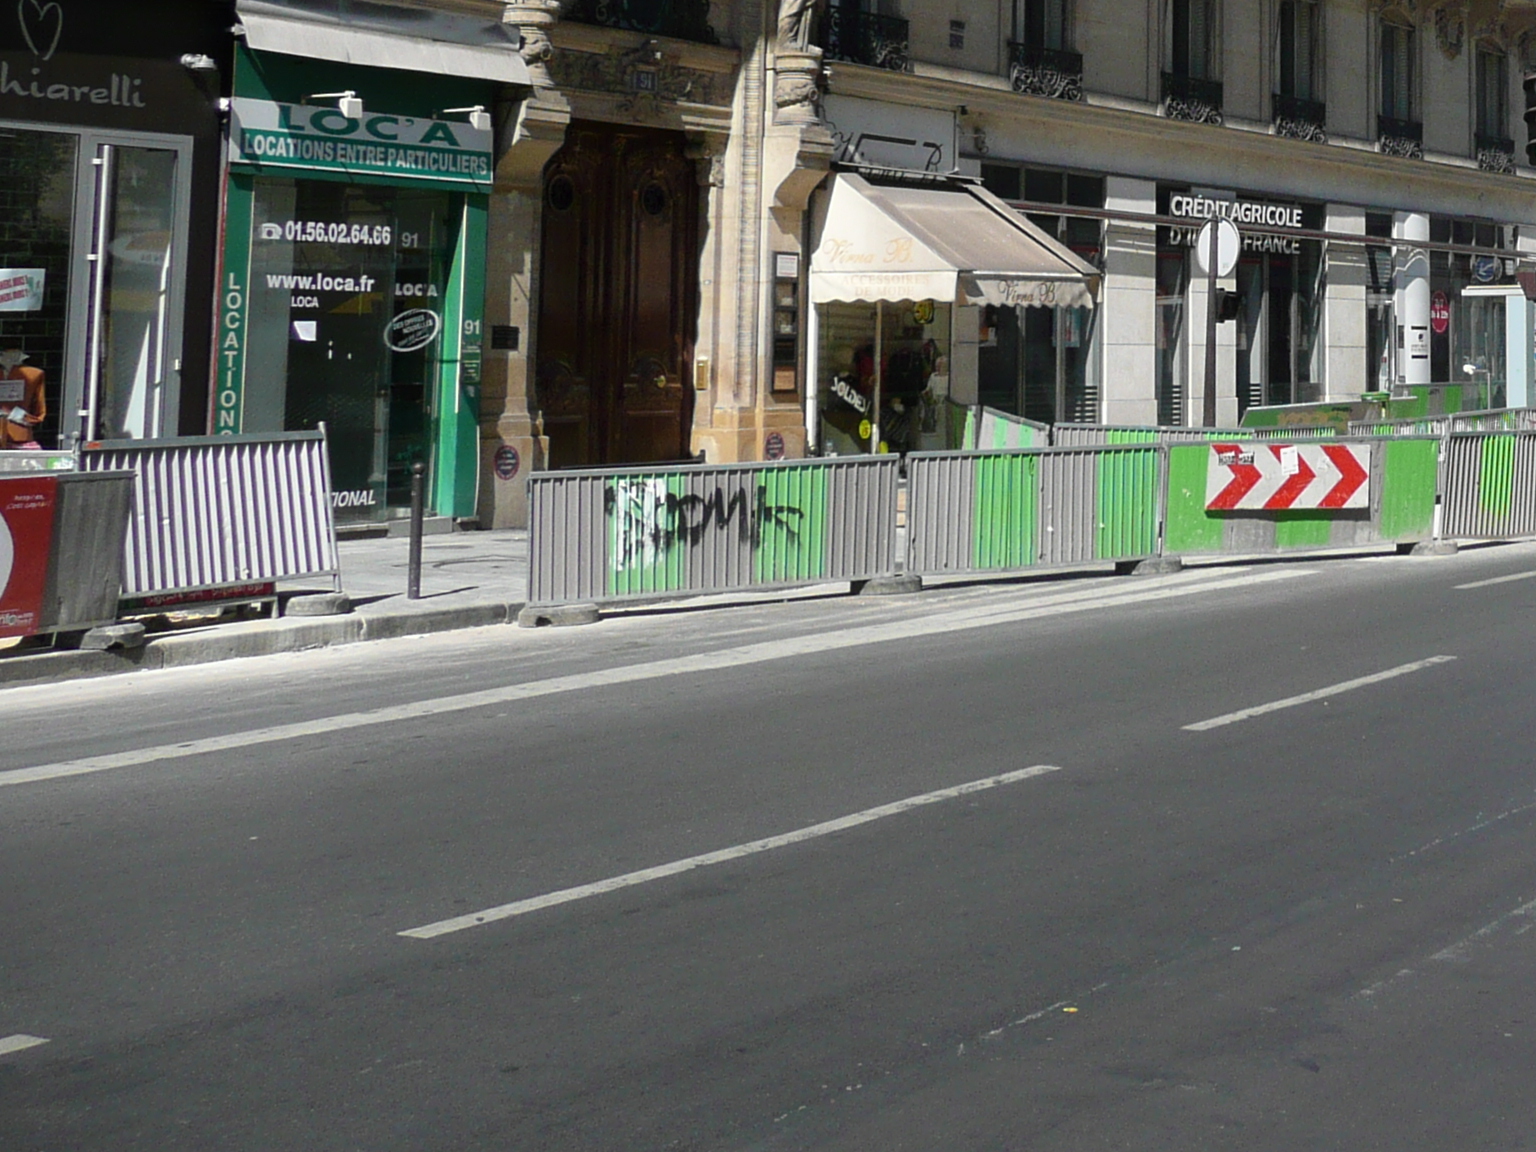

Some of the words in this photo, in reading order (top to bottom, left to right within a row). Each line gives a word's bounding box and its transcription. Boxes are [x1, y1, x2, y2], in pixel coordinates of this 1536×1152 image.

[0, 60, 147, 108] hiarelli
[278, 104, 461, 148] LOC'A
[243, 132, 335, 163] LOCATIONS
[338, 145, 386, 167] ENTRE
[387, 149, 488, 176] PARTICULIERS
[1171, 194, 1230, 219] CRÉDIT
[1231, 202, 1303, 228] AGRICOLE
[285, 220, 392, 246] 01.56.02.64.66
[401, 232, 419, 248] 91
[1243, 233, 1301, 255] FRANCE
[266, 272, 376, 292] www.loca.fr
[394, 282, 438, 297] LOC'A
[842, 274, 931, 286] ACCESSOIRES
[854, 286, 874, 297] DE
[877, 285, 915, 297] MODE
[290, 295, 320, 308] LOCA
[463, 319, 480, 335] 91
[219, 272, 242, 436] LOCATION
[329, 488, 377, 508] IONAL
